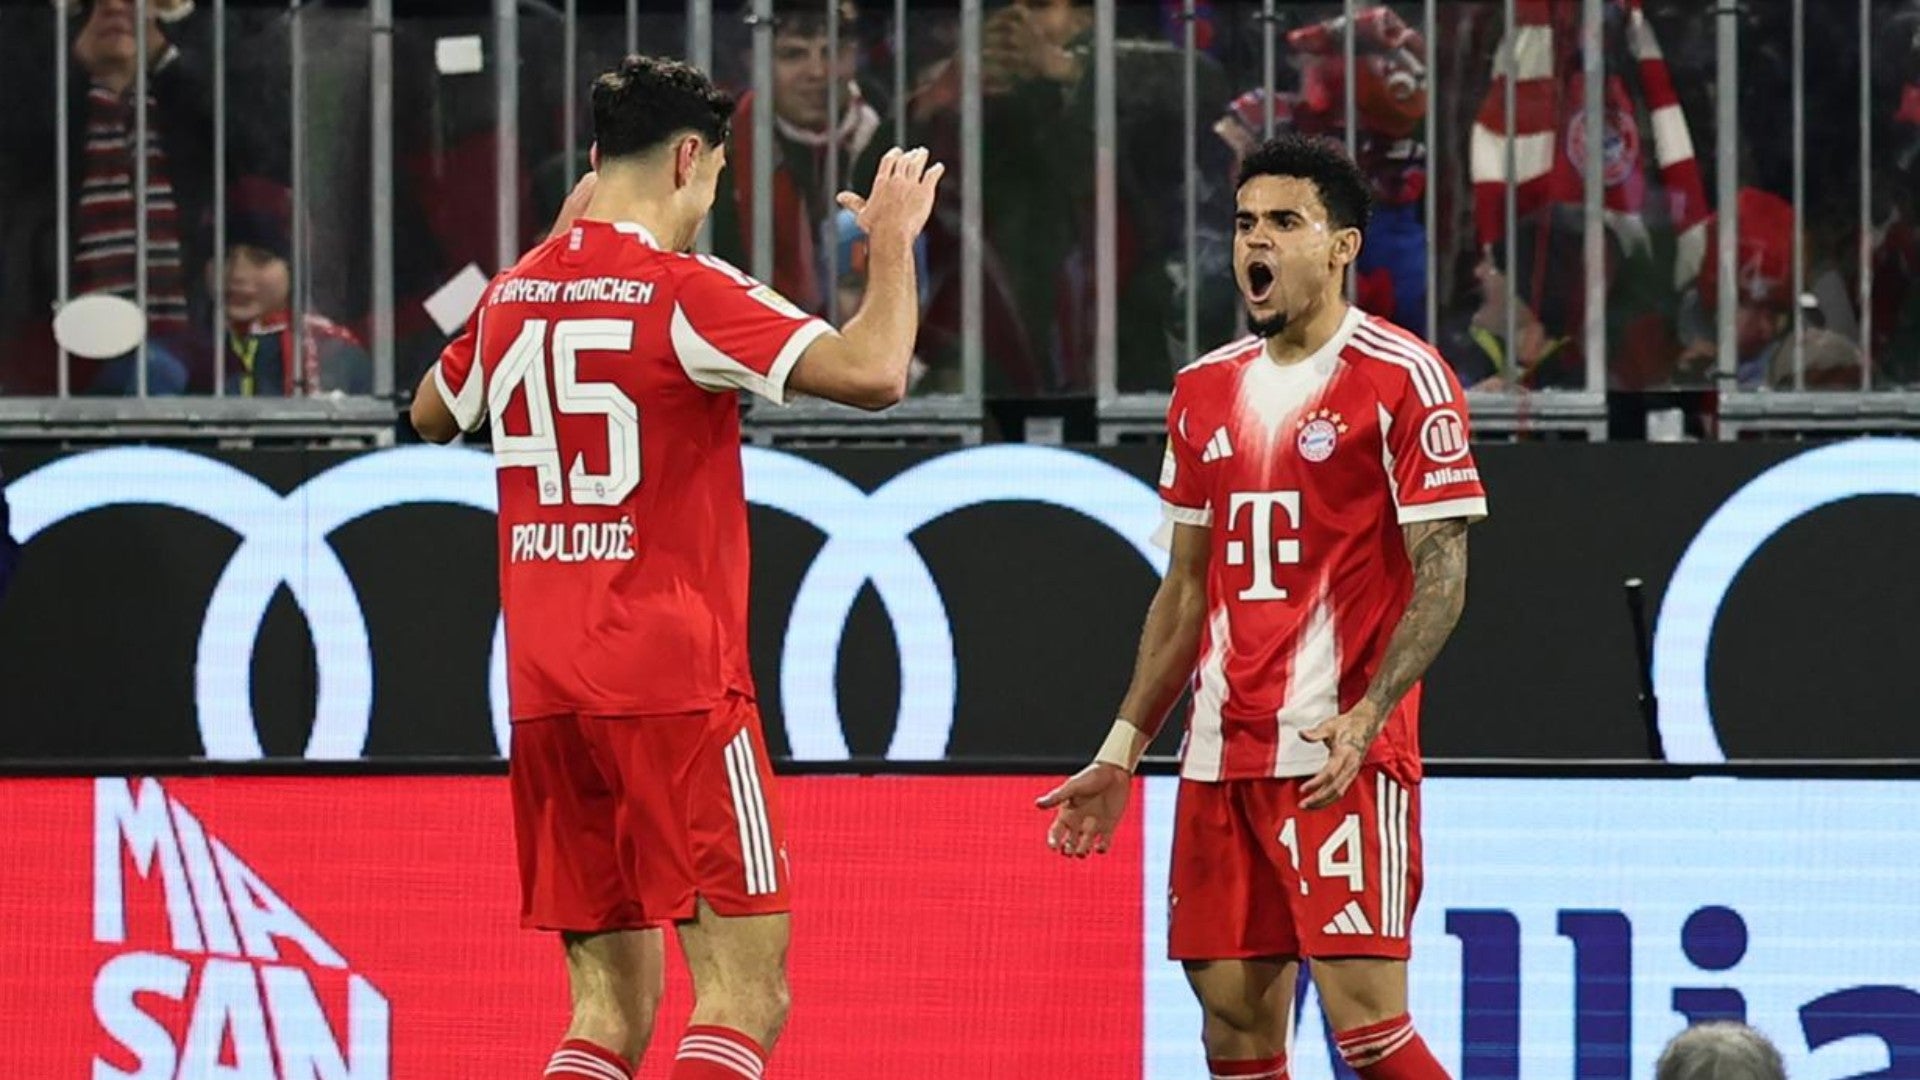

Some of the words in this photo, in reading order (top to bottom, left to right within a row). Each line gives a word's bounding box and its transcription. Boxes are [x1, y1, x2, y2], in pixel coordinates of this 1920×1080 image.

[502, 277, 561, 302] BAYERN
[488, 319, 641, 505] 45
[511, 515, 635, 563] PAVLOVIĆ
[1226, 491, 1300, 601] T
[94, 777, 348, 968] MIA
[1278, 816, 1364, 895] 14
[93, 950, 391, 1080] SAN
